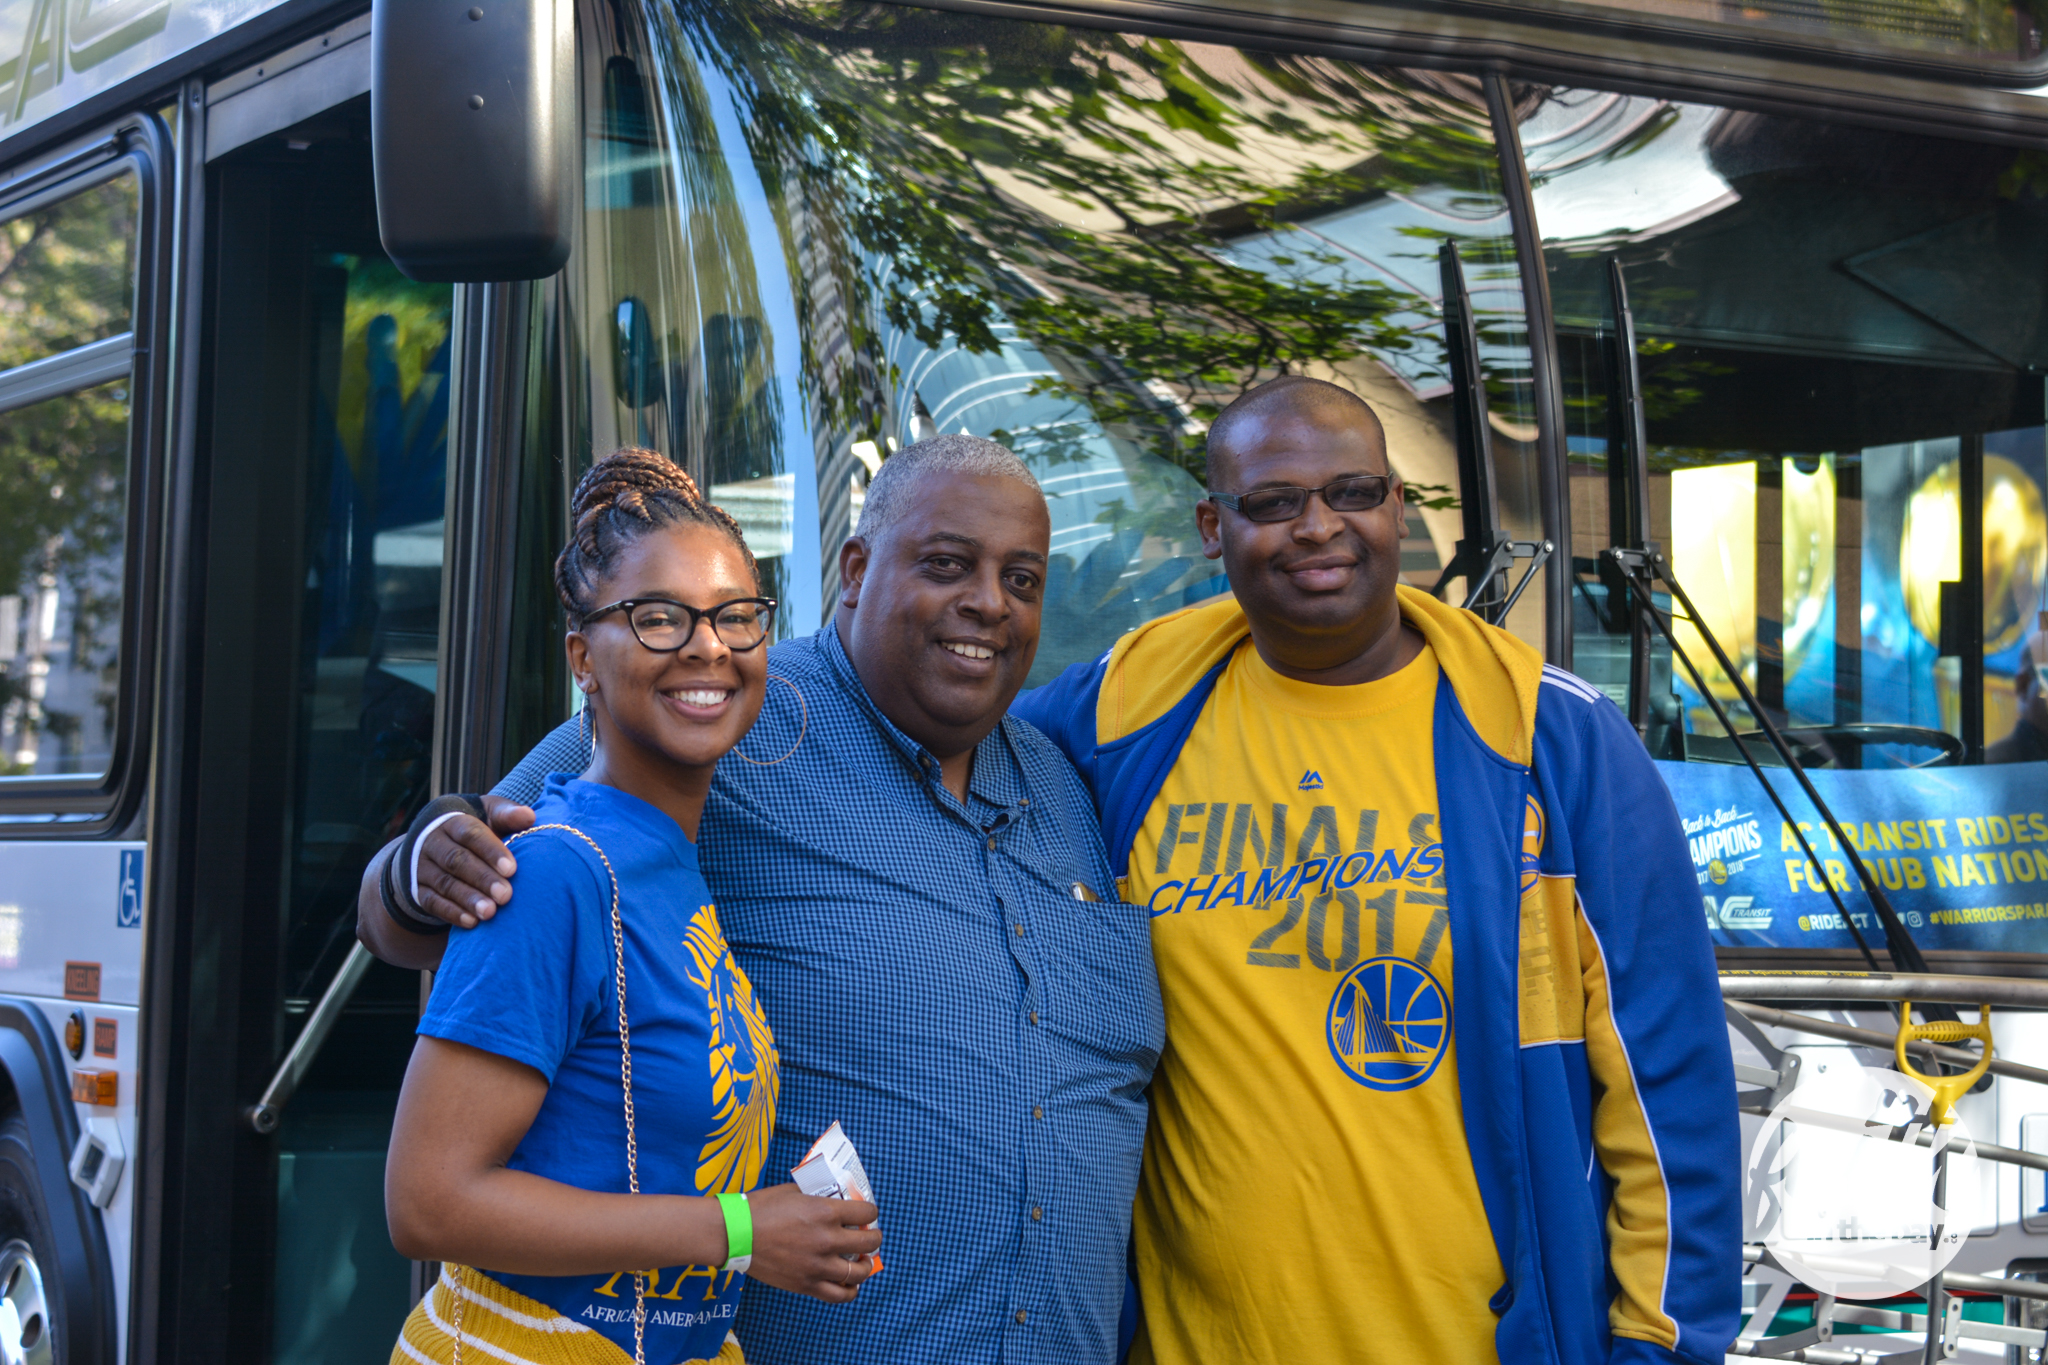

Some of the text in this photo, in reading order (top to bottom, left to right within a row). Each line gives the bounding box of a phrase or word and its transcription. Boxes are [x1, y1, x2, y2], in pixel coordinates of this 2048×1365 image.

[1711, 804, 1738, 829] Back
[1819, 819, 1947, 852] TRANSIT
[1955, 812, 2048, 847] RIDES
[1154, 802, 1445, 888] FINALS
[1690, 820, 1762, 866] AMPIONS
[1150, 843, 1444, 919] CHAMPIONS
[1727, 860, 1744, 875] 2018
[1784, 858, 1852, 893] FOR
[1931, 848, 2048, 888] NATION
[1733, 908, 1773, 917] TRANSIT
[1798, 911, 1869, 932] @RIDECT
[1929, 902, 2048, 926] #WARRIORSPAR
[1246, 886, 1449, 972] 2017
[581, 1303, 649, 1324] AFRICAN
[650, 1309, 712, 1328] AMERAN
